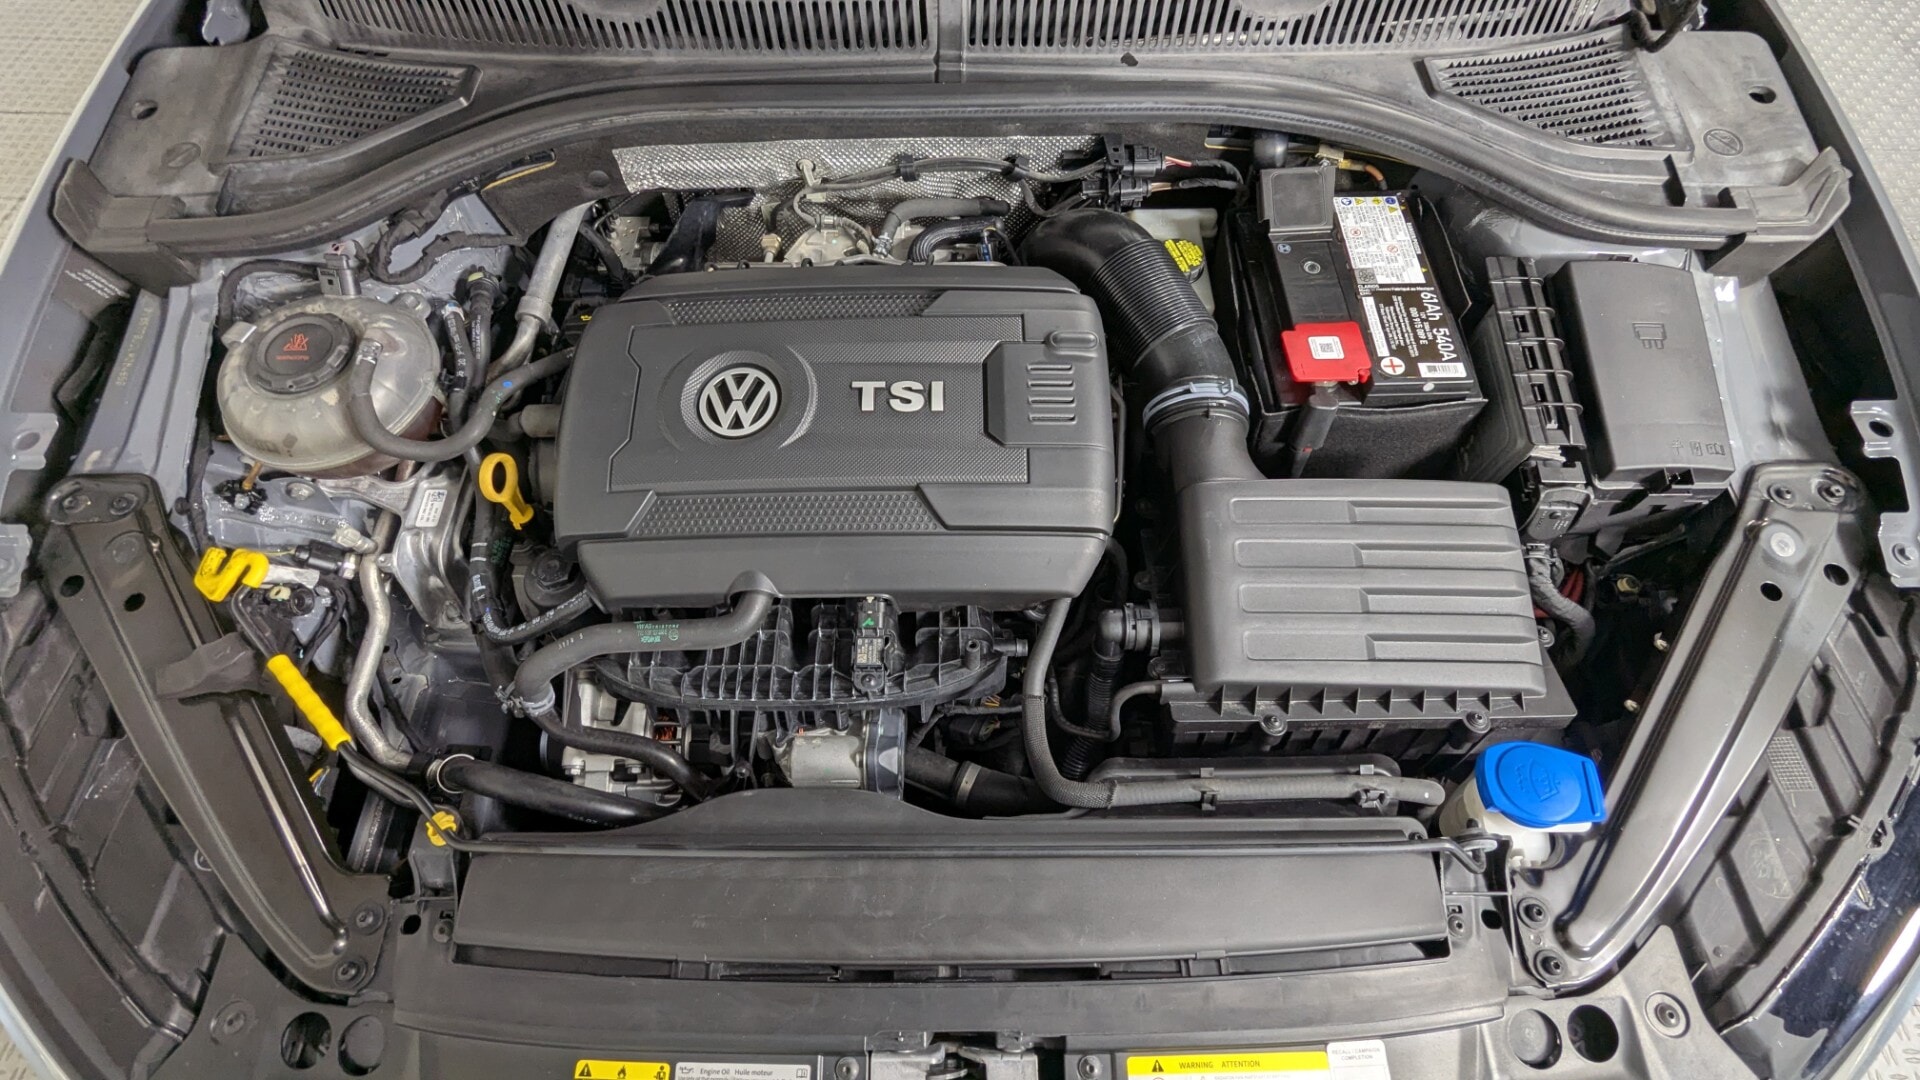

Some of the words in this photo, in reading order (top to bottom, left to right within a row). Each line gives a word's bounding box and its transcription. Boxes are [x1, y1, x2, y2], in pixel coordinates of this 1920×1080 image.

[1413, 318, 1422, 328] 915
[1420, 292, 1443, 320] 61Ah
[1432, 328, 1457, 361] 540A
[851, 380, 944, 412] TSI
